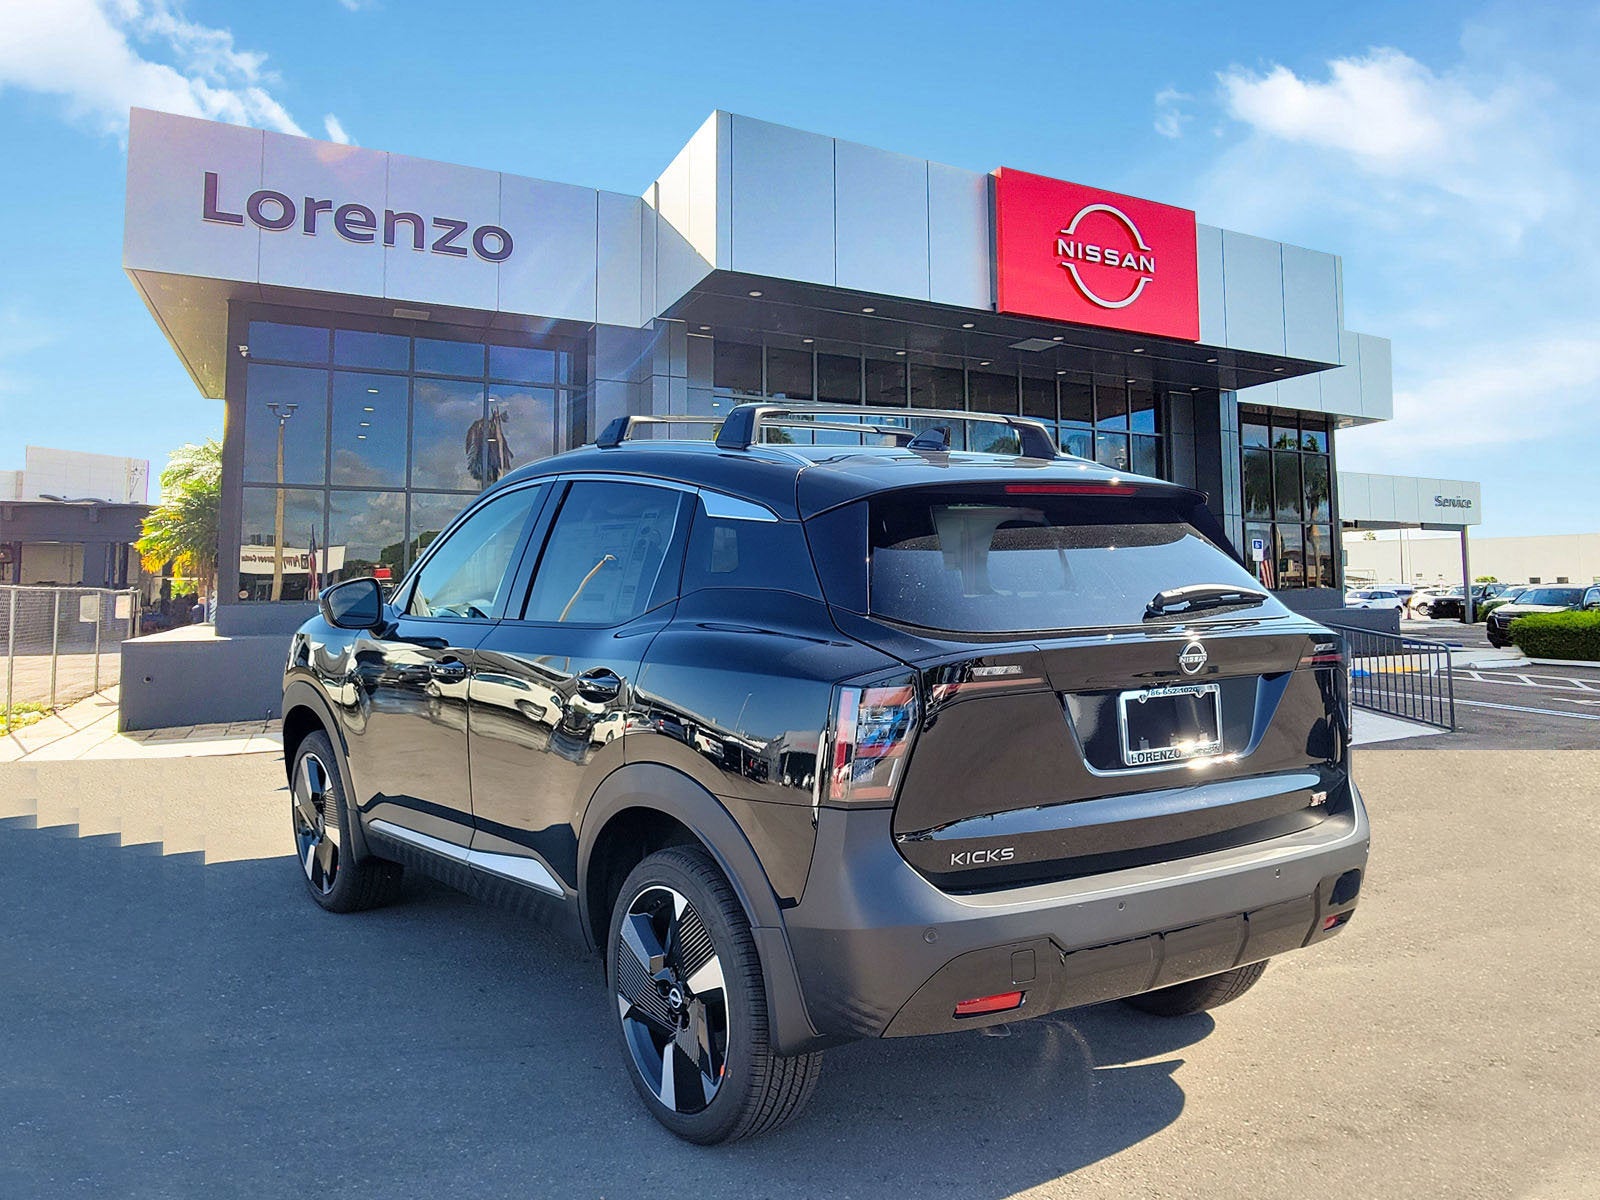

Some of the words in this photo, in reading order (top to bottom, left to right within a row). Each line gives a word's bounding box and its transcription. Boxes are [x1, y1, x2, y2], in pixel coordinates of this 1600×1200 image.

[203, 171, 514, 262] Lorenzo
[1057, 238, 1155, 273] NISSAN
[1434, 495, 1472, 509] Service
[1131, 748, 1181, 764] LORENZO
[950, 847, 1014, 866] KICKS
